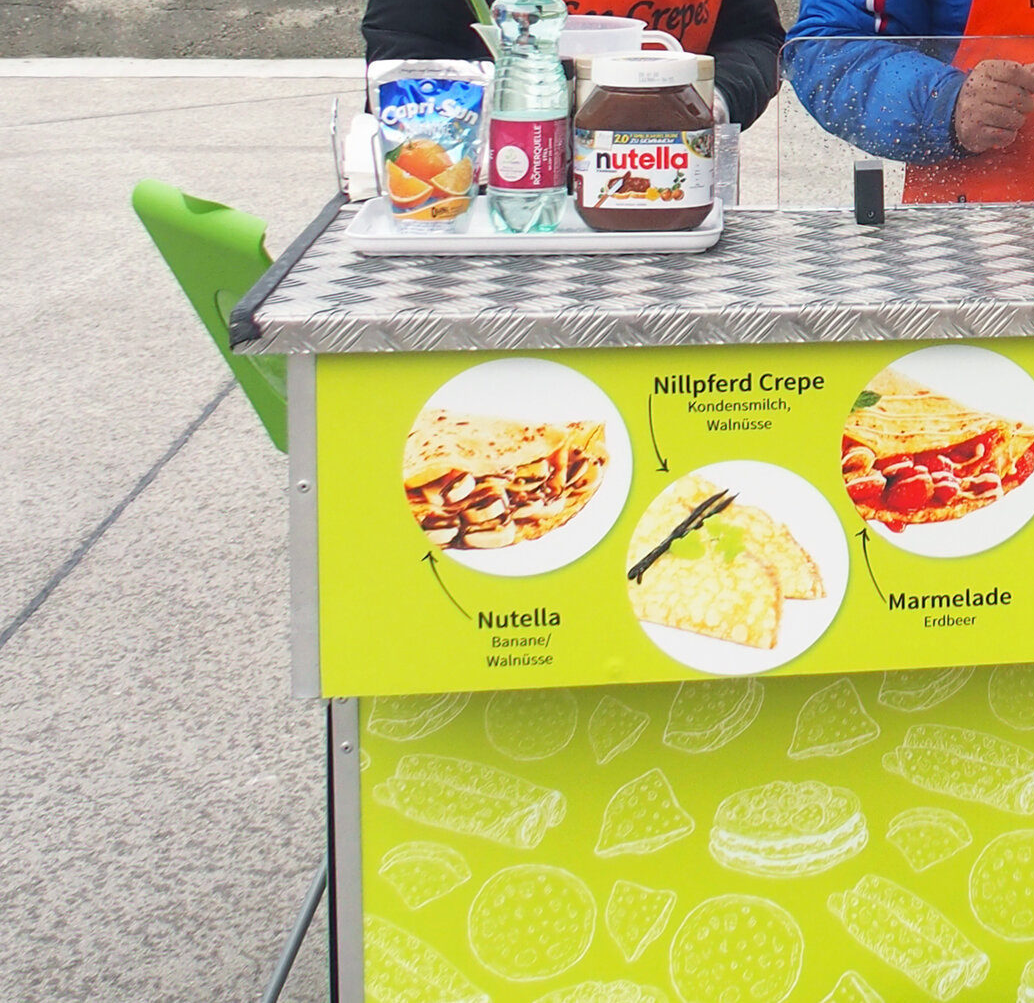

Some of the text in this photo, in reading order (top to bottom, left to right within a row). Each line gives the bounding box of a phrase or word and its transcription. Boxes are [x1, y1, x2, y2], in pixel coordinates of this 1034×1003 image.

[381, 97, 479, 126] Capri-Sun
[530, 125, 543, 186] RÖMERQUELLE
[596, 146, 688, 170] nutella
[654, 373, 825, 398] Nillpferd Crepe
[688, 398, 791, 413] Kondensmilch,
[707, 418, 773, 431] Walnüsse
[889, 587, 1012, 610] Marmelade
[478, 607, 561, 629] Nutella
[924, 614, 976, 627] Erdbeer
[492, 633, 552, 648] Banane/
[486, 654, 554, 667] Walnüsse
